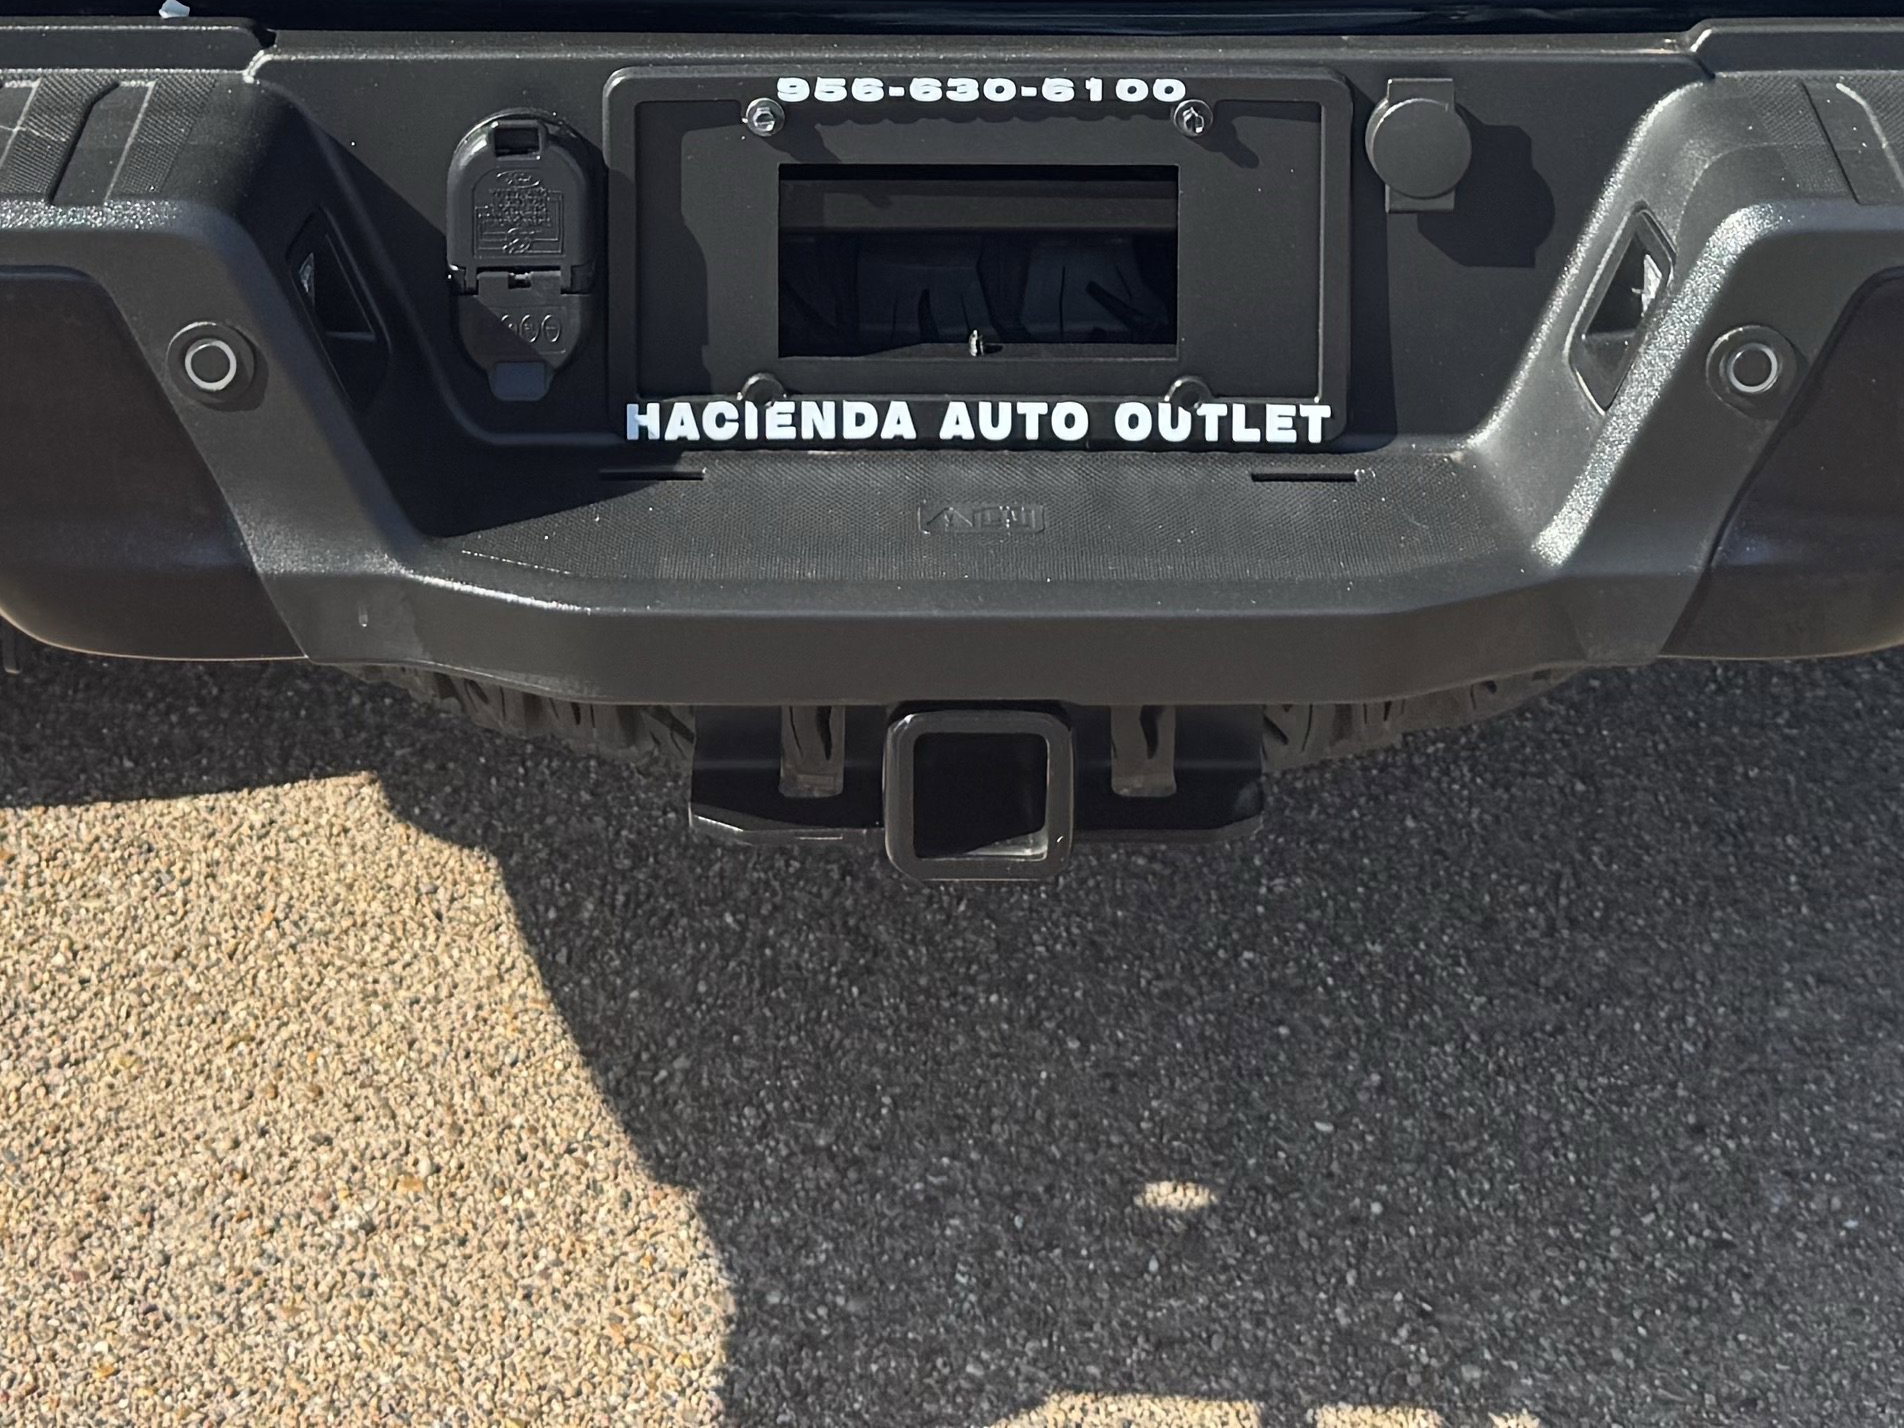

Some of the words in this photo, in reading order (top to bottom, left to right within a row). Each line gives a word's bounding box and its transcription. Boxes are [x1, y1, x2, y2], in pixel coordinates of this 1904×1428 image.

[777, 77, 1187, 102] 956-630-6100
[626, 400, 918, 441] HACIENDA
[940, 400, 1089, 441] AUTO
[1115, 402, 1331, 443] OUTLET
